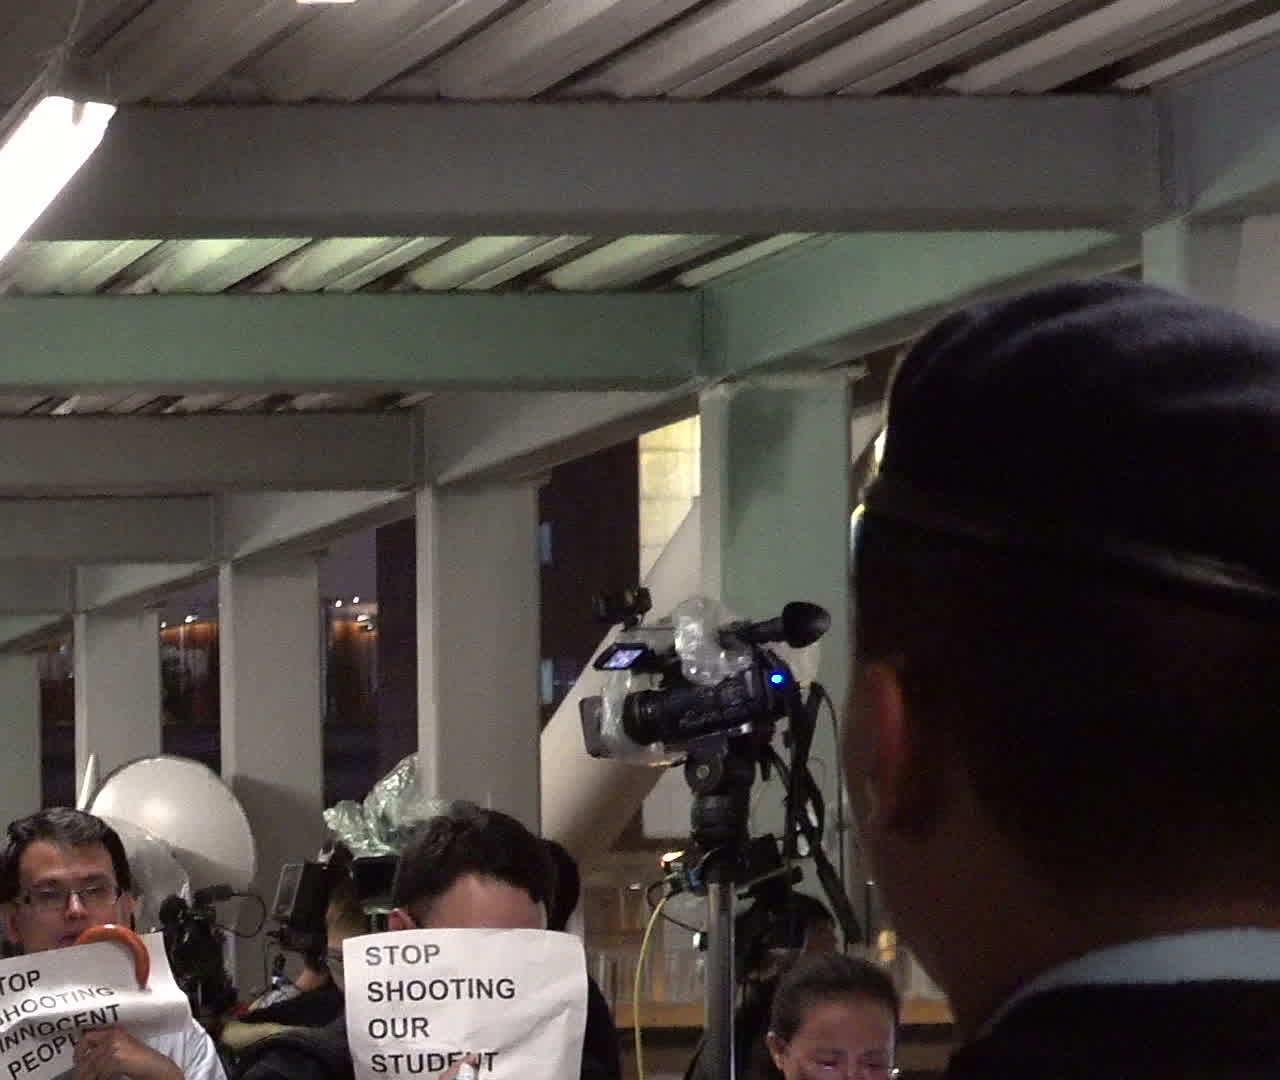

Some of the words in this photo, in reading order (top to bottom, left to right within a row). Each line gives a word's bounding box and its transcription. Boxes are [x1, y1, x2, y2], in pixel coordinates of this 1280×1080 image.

[366, 944, 441, 966] STOP
[367, 978, 516, 1002] SHOOTING
[368, 1016, 430, 1040] OUR
[7, 1032, 81, 1080] PEOPL
[371, 1051, 500, 1074] STUDET
